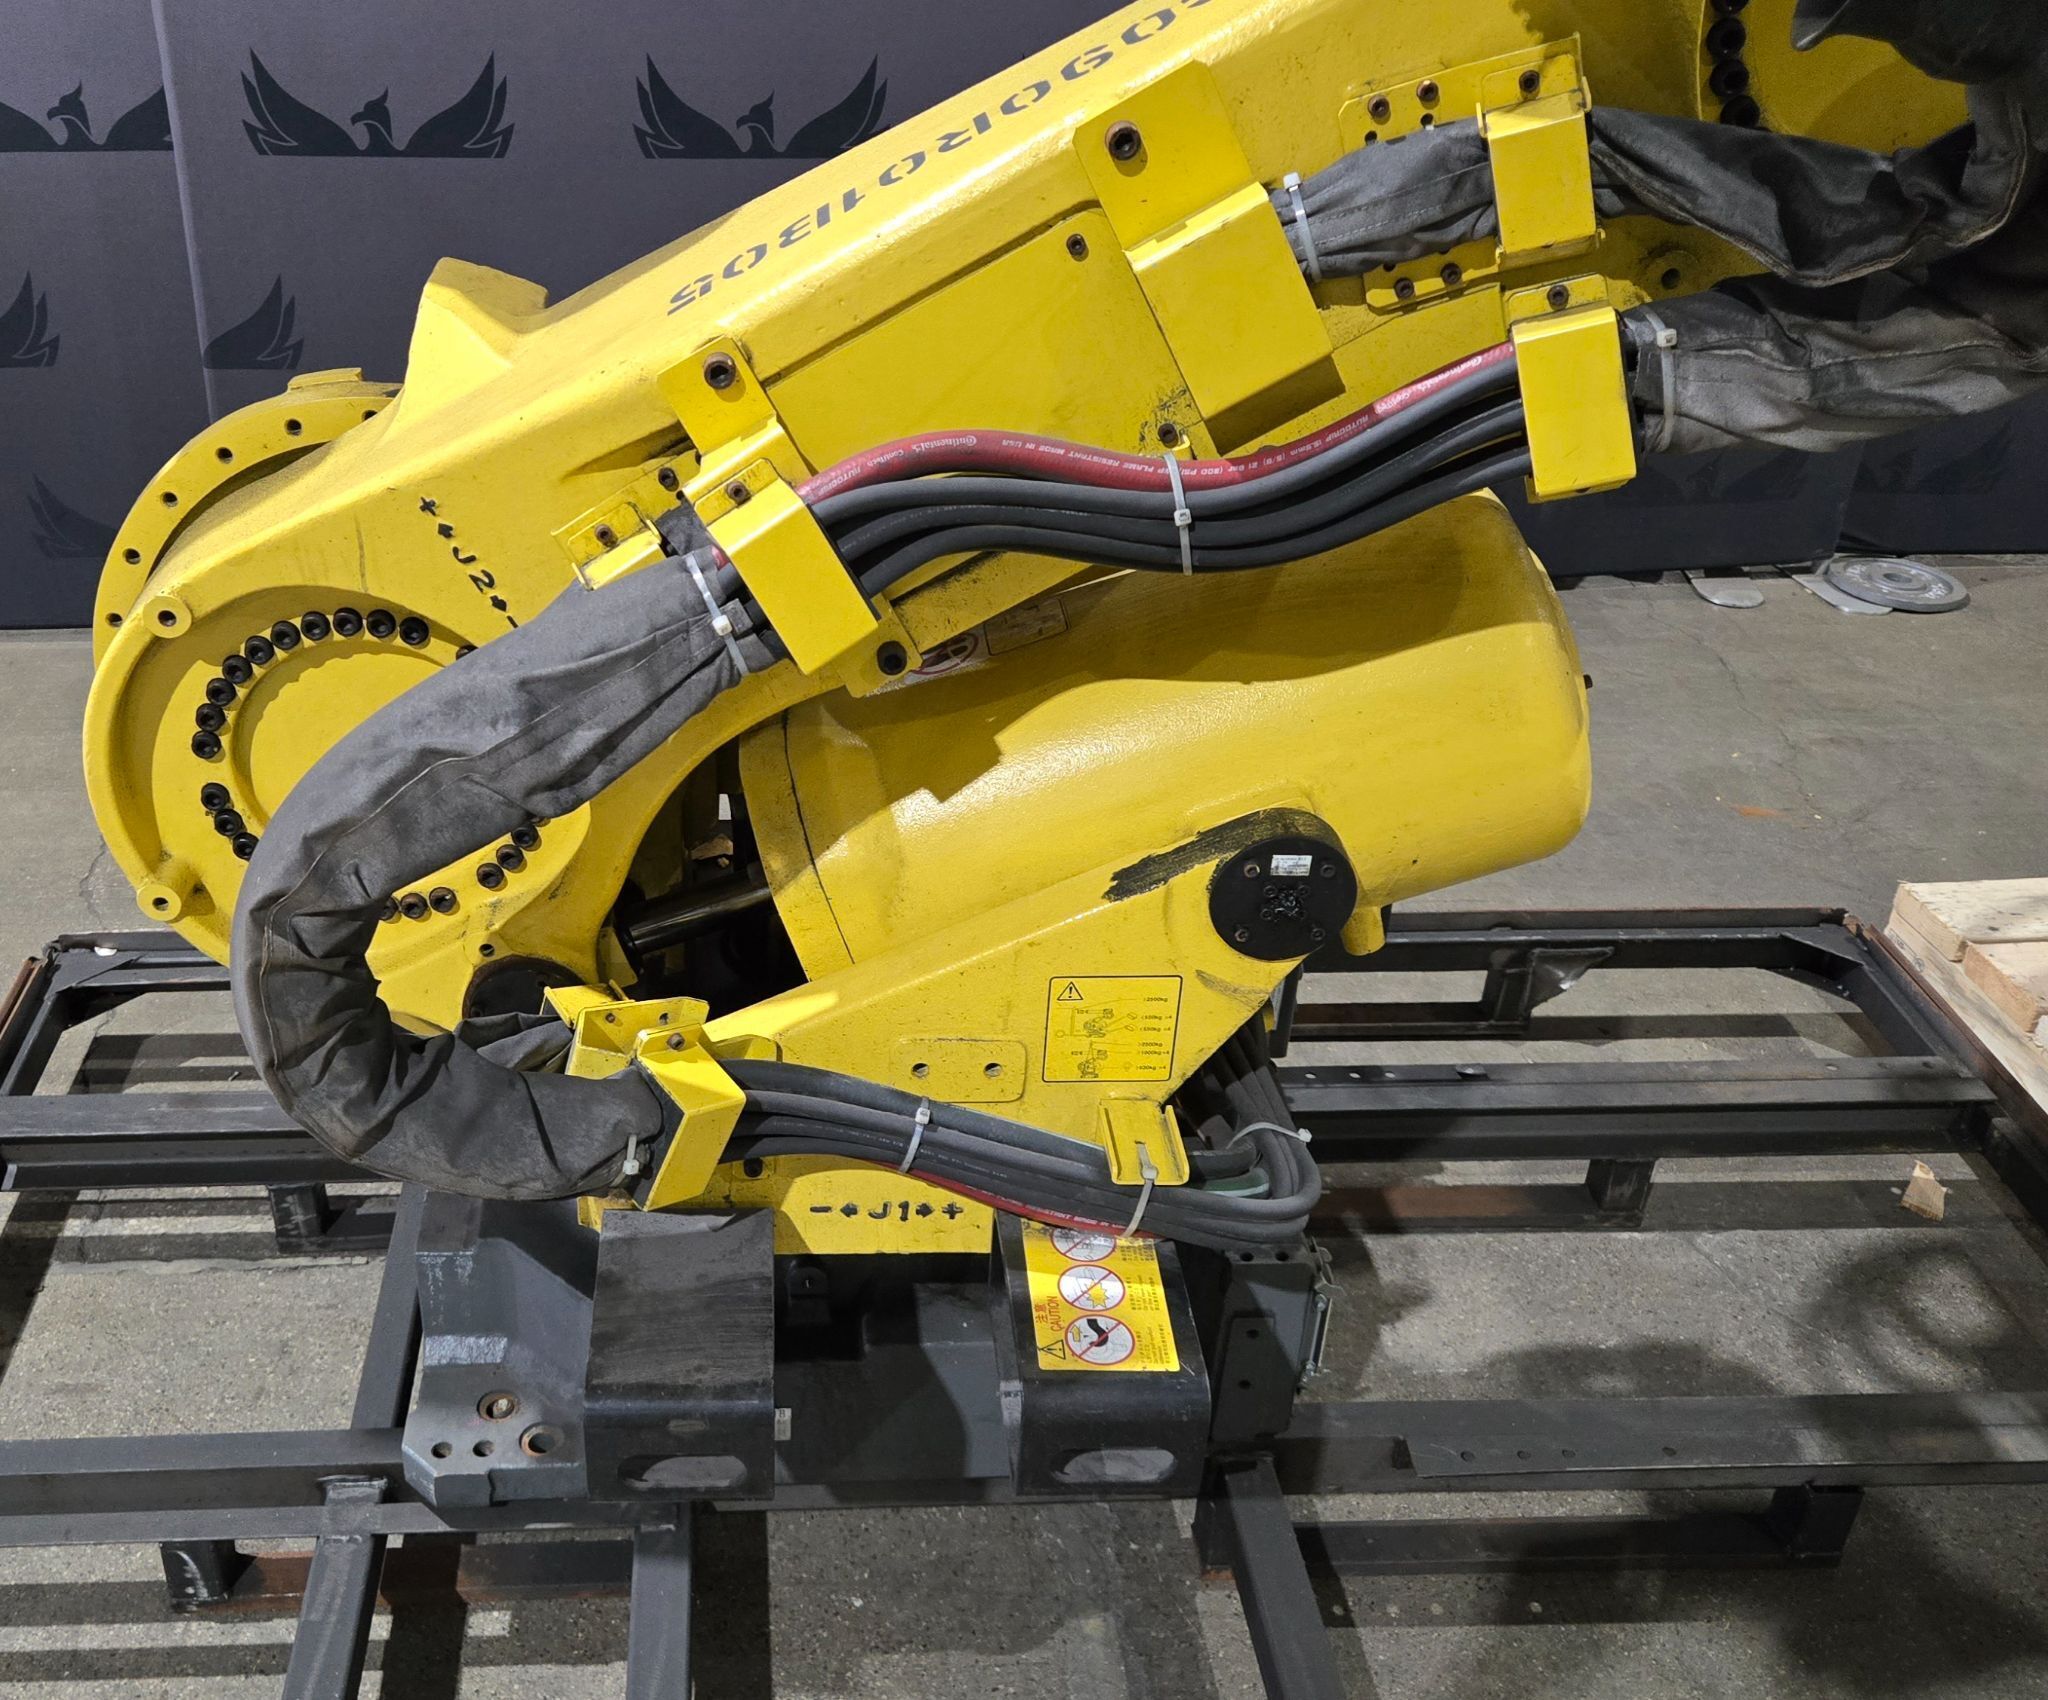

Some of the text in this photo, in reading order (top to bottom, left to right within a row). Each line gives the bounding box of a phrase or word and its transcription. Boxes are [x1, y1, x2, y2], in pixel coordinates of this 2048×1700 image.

[667, 0, 1211, 316] 090R01B05
[921, 435, 977, 453] Continental
[1001, 439, 1023, 448] USA
[1025, 442, 1035, 450] IN
[1038, 444, 1065, 455] MADE
[1067, 450, 1120, 467] RESISTANT
[1034, 1302, 1049, 1324] 注意
[1050, 1295, 1065, 1333] CAUTION
